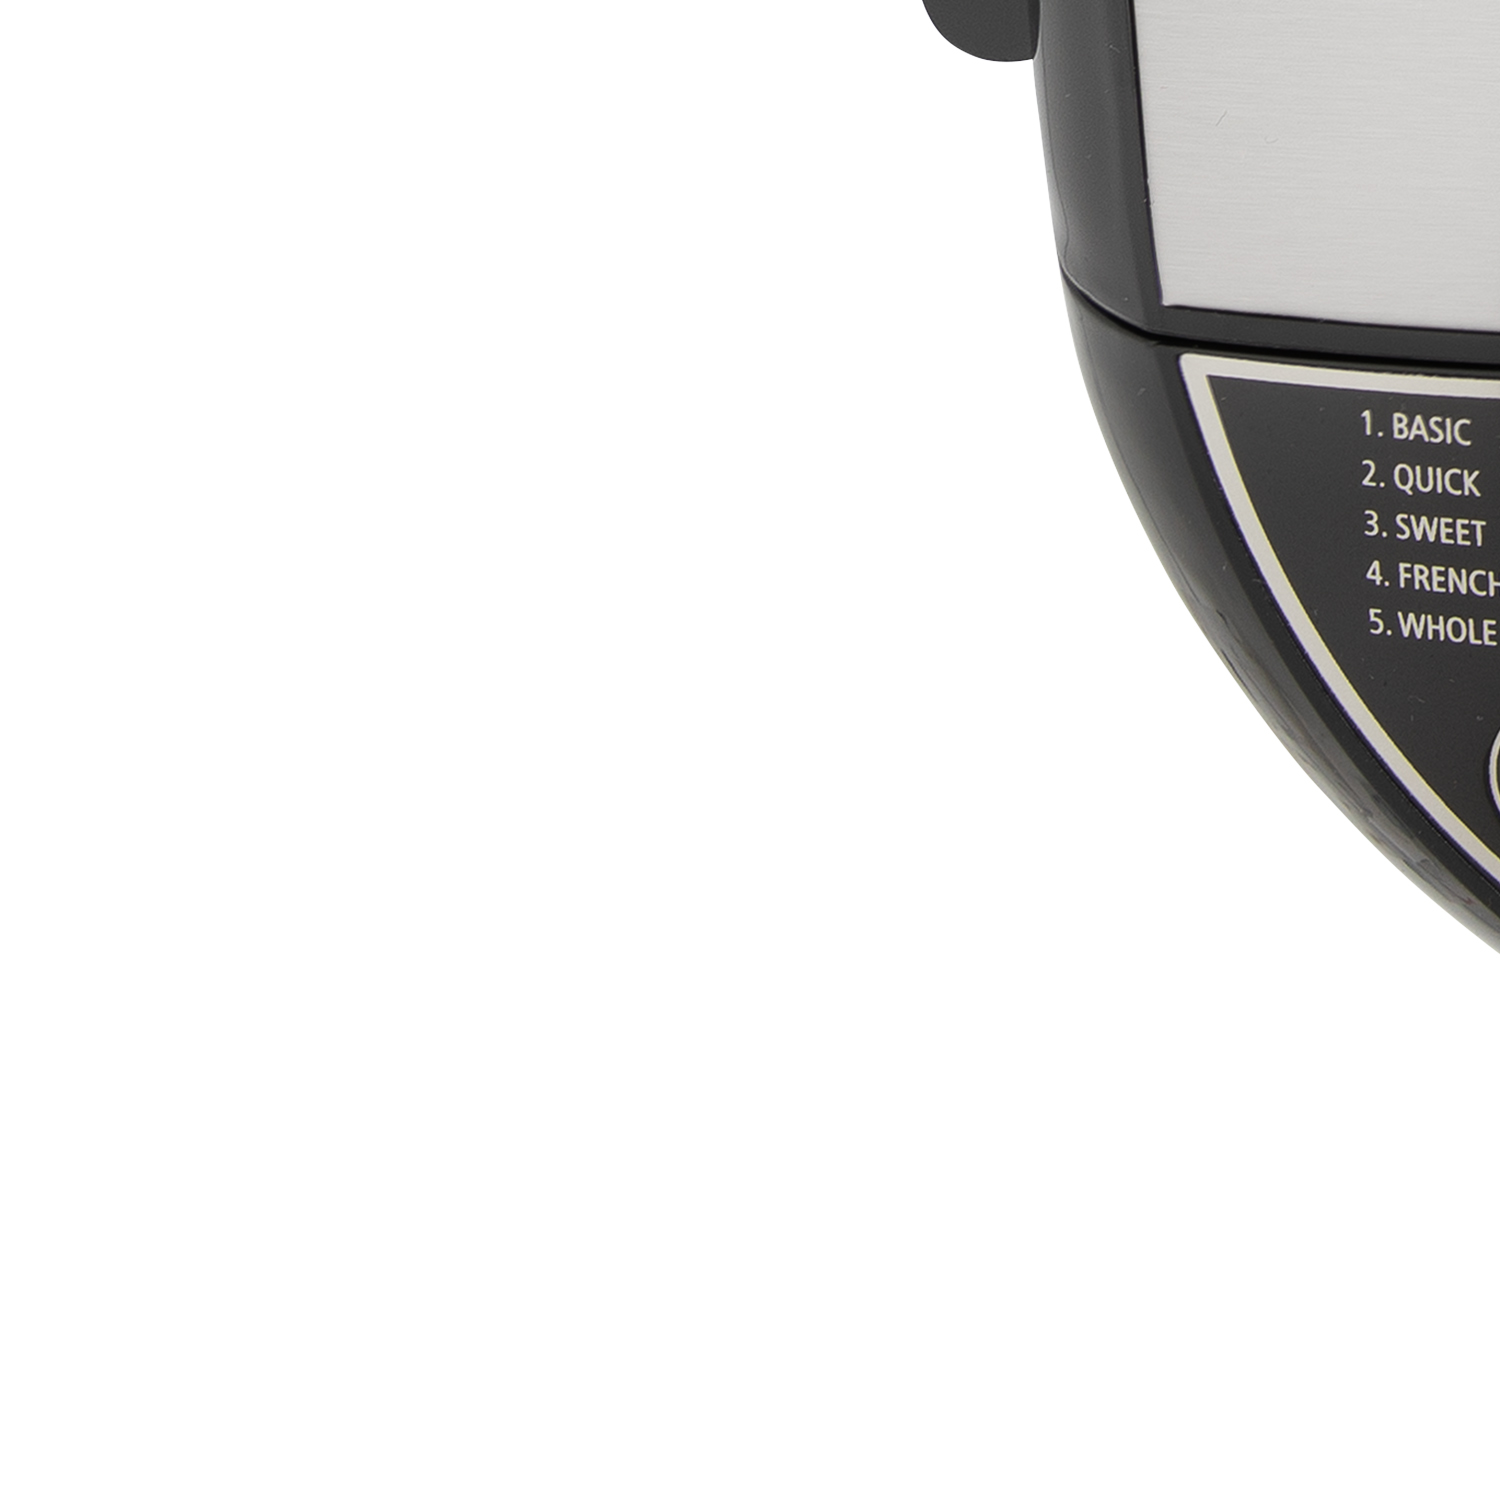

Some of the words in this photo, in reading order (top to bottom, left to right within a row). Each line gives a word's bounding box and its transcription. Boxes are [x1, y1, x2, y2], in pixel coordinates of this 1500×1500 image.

[1361, 409, 1384, 437] 1.
[1392, 412, 1472, 446] BASIC
[1361, 459, 1385, 488] 2.
[1393, 463, 1481, 497] QUICK
[1364, 509, 1388, 538] 3.
[1395, 513, 1487, 547] SWEET
[1366, 560, 1390, 587] 4.
[1368, 608, 1392, 636] 5.
[1397, 611, 1498, 646] WHOLE
